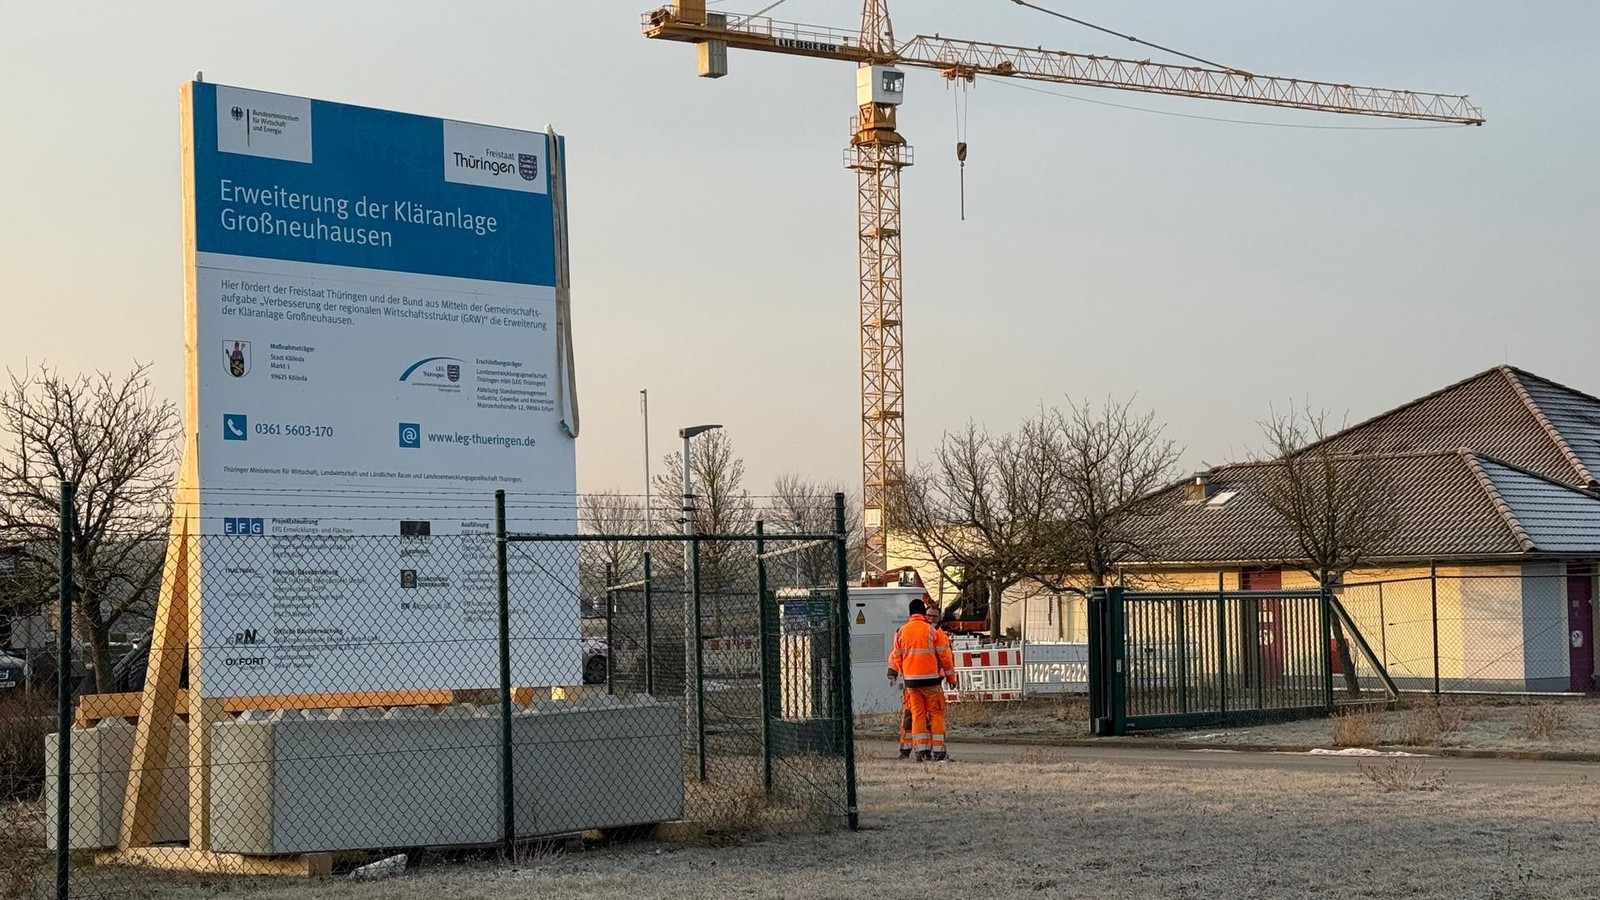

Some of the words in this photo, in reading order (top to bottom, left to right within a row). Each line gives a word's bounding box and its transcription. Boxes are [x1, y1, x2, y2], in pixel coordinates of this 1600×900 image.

[778, 39, 836, 52] LIEBHERR
[252, 110, 300, 122] Bundesministerium
[260, 118, 286, 127] Wirtschaft
[264, 126, 282, 135] Energie
[486, 148, 515, 160] Freistaat
[453, 152, 515, 176] Thüringen
[220, 178, 349, 220] Erweiterung
[355, 196, 388, 220] der
[395, 200, 498, 236] Kläranlage
[220, 208, 393, 248] Großneuhausen
[221, 280, 239, 290] Hier
[241, 281, 270, 293] fördert
[273, 284, 287, 294] der
[289, 286, 325, 298] Freistaat
[327, 289, 368, 302] Thüringen
[370, 294, 385, 304] und
[387, 296, 400, 304] der
[402, 296, 423, 307] Bund
[425, 300, 439, 308] aus
[441, 300, 468, 311] Mitteln
[470, 302, 483, 312] der
[484, 304, 542, 317] Gemeinschafts-
[221, 293, 258, 305] aufgabe
[260, 296, 322, 312] „Verbesserung
[323, 300, 337, 311] der
[339, 304, 382, 316] regionalen
[384, 307, 459, 323] Wirtschaftsstruktur
[490, 317, 502, 325] die
[504, 318, 547, 331] Erweiterung
[221, 305, 236, 315] der
[238, 306, 284, 321] Kläranlage
[286, 310, 355, 325] Großneuhausen.
[255, 423, 281, 436] 0361
[285, 425, 334, 438] 5603-170
[428, 432, 535, 448] www.leg-thueringen.de
[224, 466, 249, 474] Thüringer
[225, 522, 261, 533] EFG
